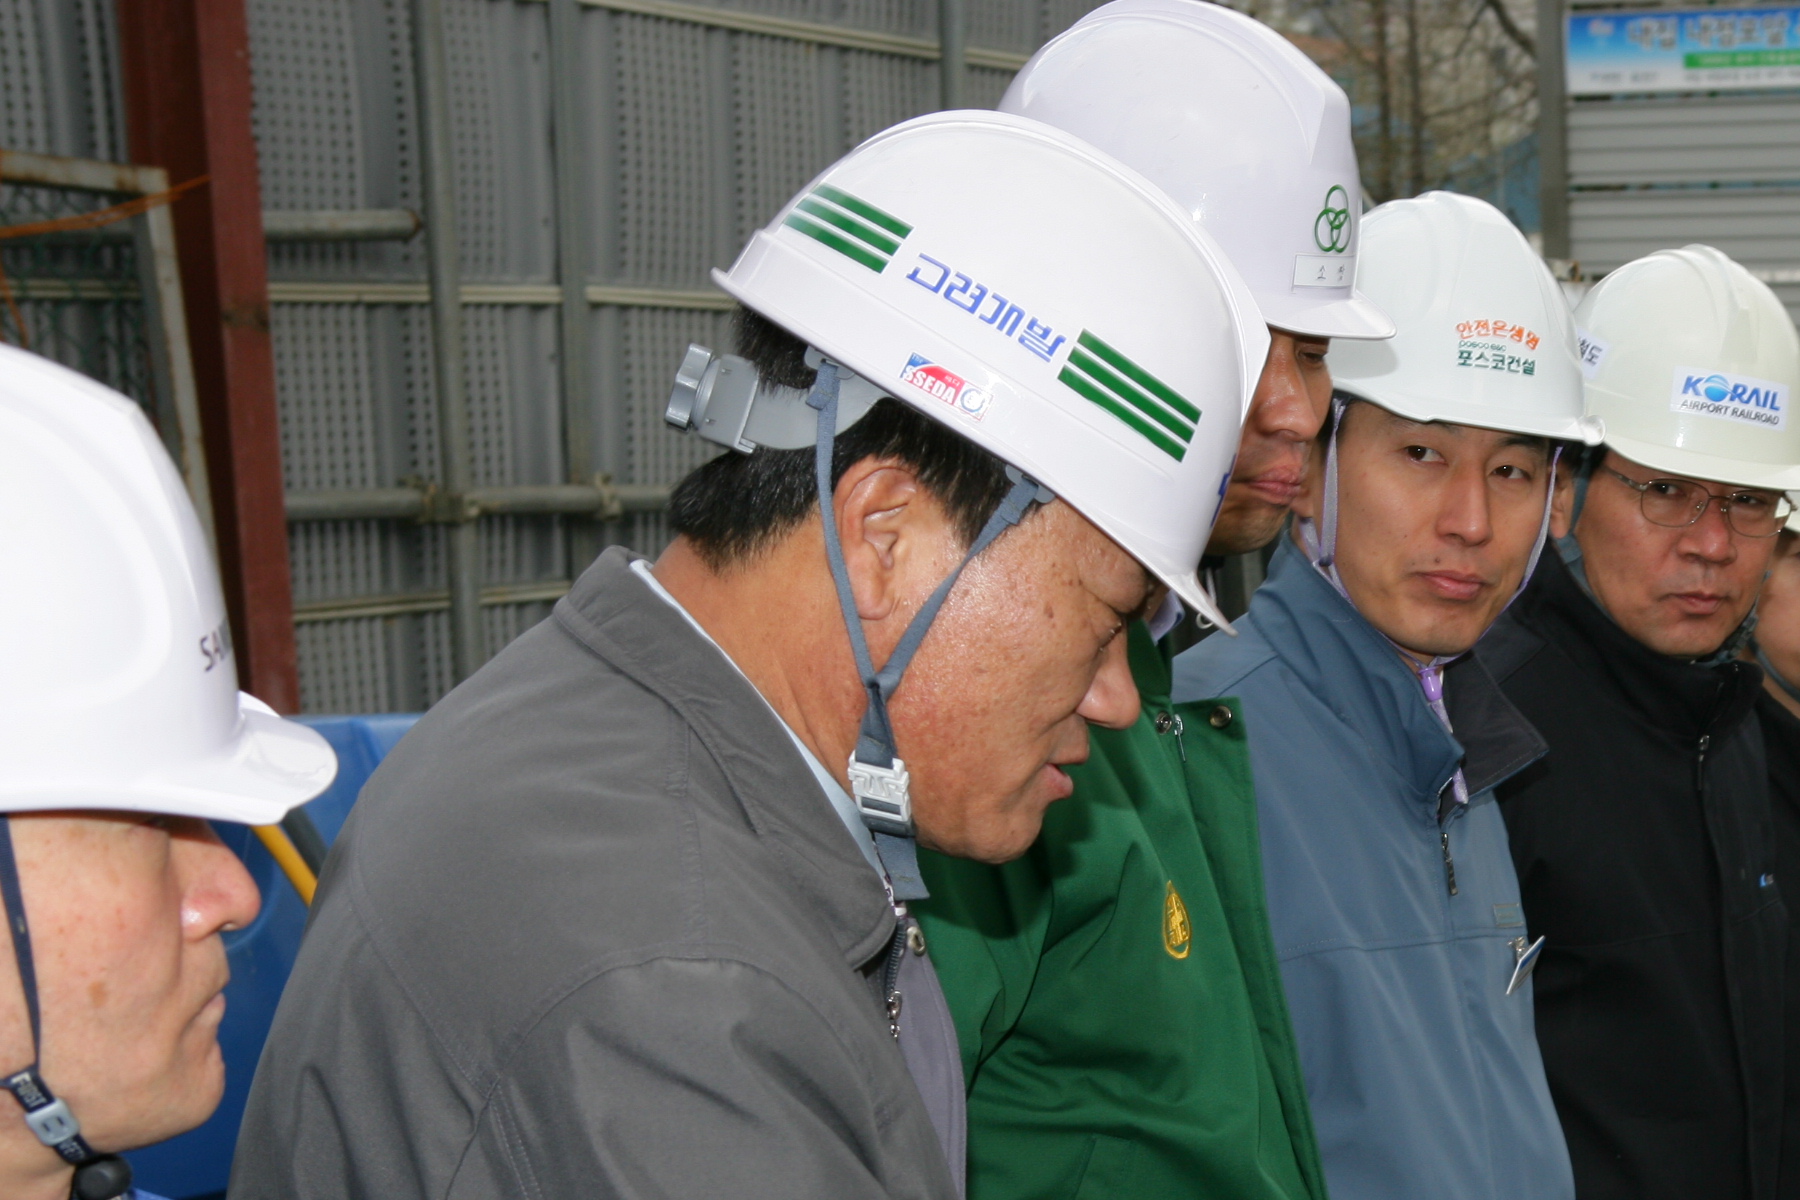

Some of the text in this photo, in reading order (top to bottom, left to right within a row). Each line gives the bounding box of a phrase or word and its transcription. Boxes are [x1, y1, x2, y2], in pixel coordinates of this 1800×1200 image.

[905, 252, 1067, 363] 고려개발
[1457, 350, 1536, 376] 포스코건설
[1682, 374, 1781, 411] KORAIL
[1681, 399, 1780, 426] AIRPORT RAILROAD
